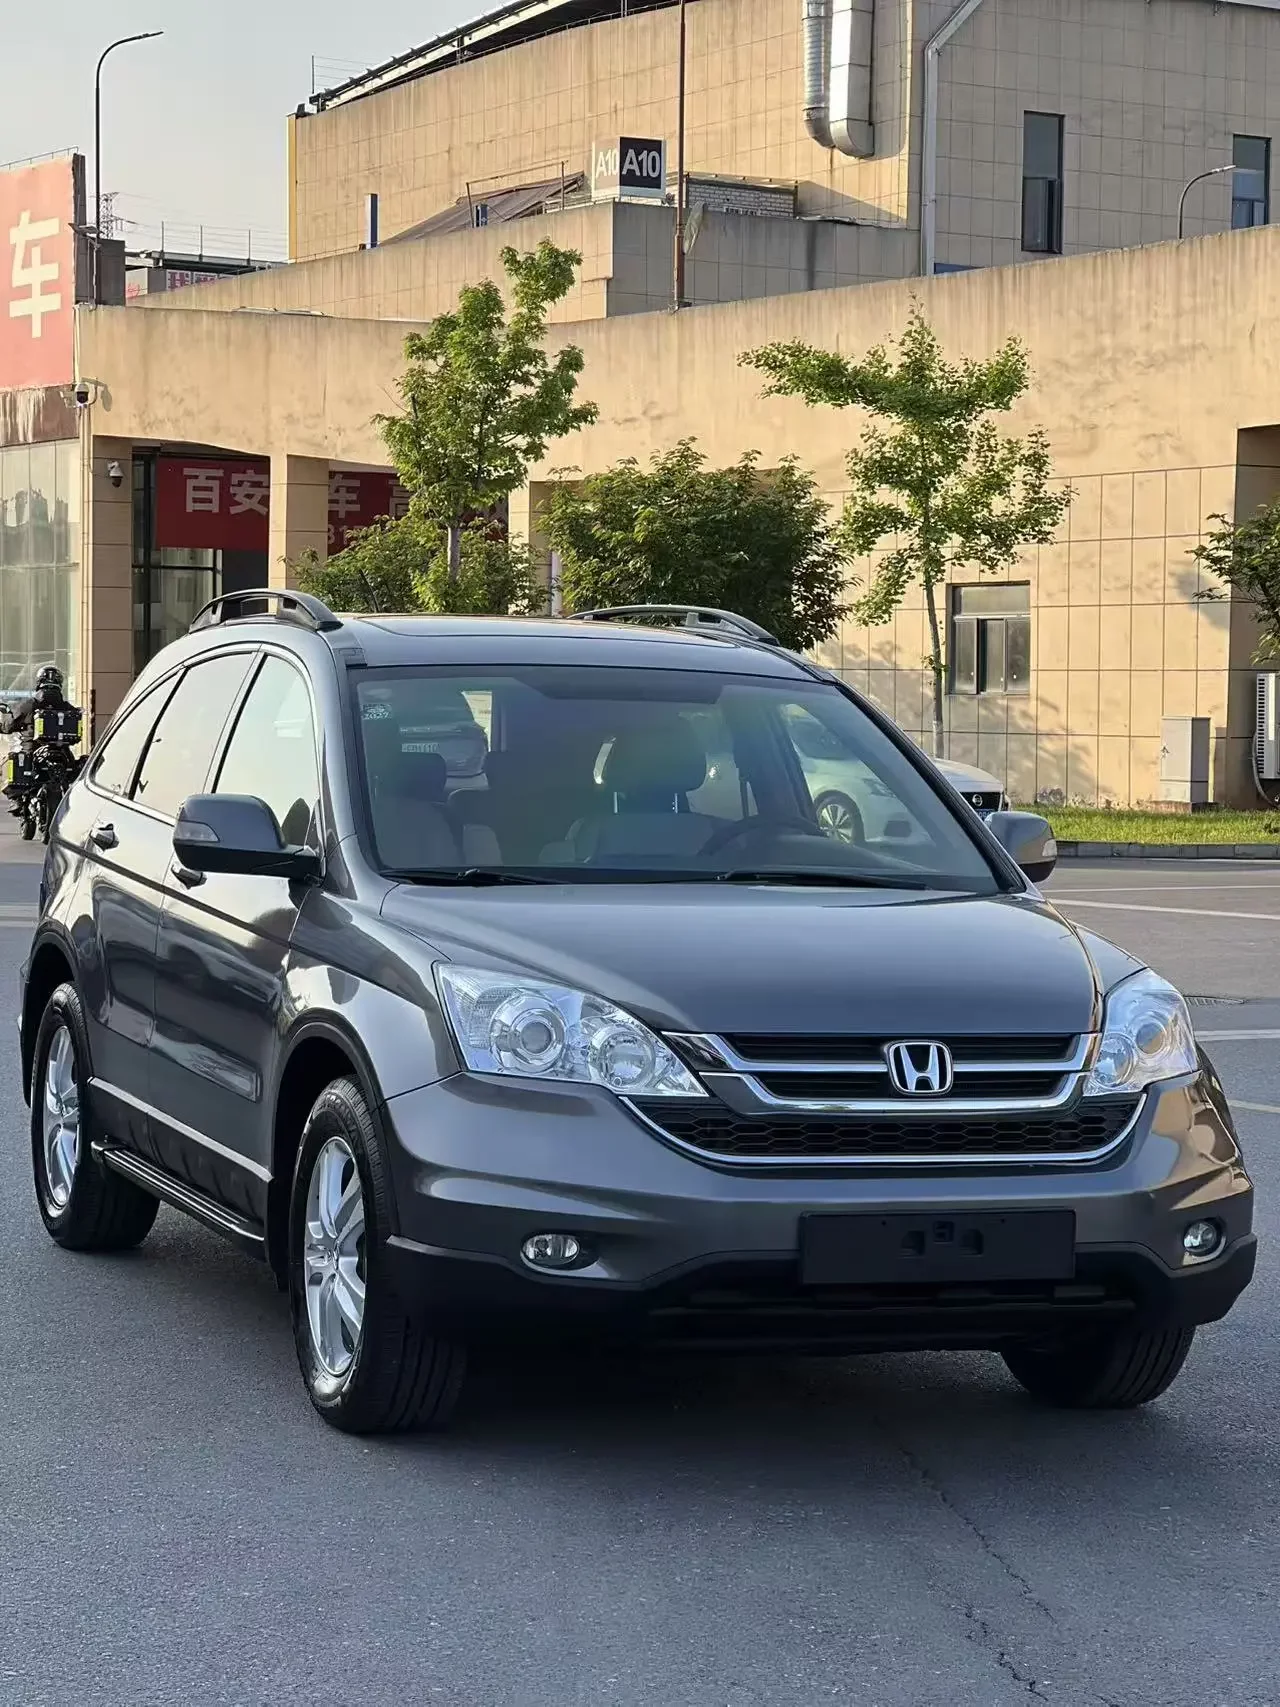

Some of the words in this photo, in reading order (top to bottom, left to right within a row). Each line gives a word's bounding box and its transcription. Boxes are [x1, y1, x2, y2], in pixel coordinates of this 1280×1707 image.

[596, 149, 618, 178] A10
[621, 148, 661, 177] A10
[9, 209, 61, 338] 车
[183, 467, 270, 515] 百安
[328, 473, 361, 518] 车
